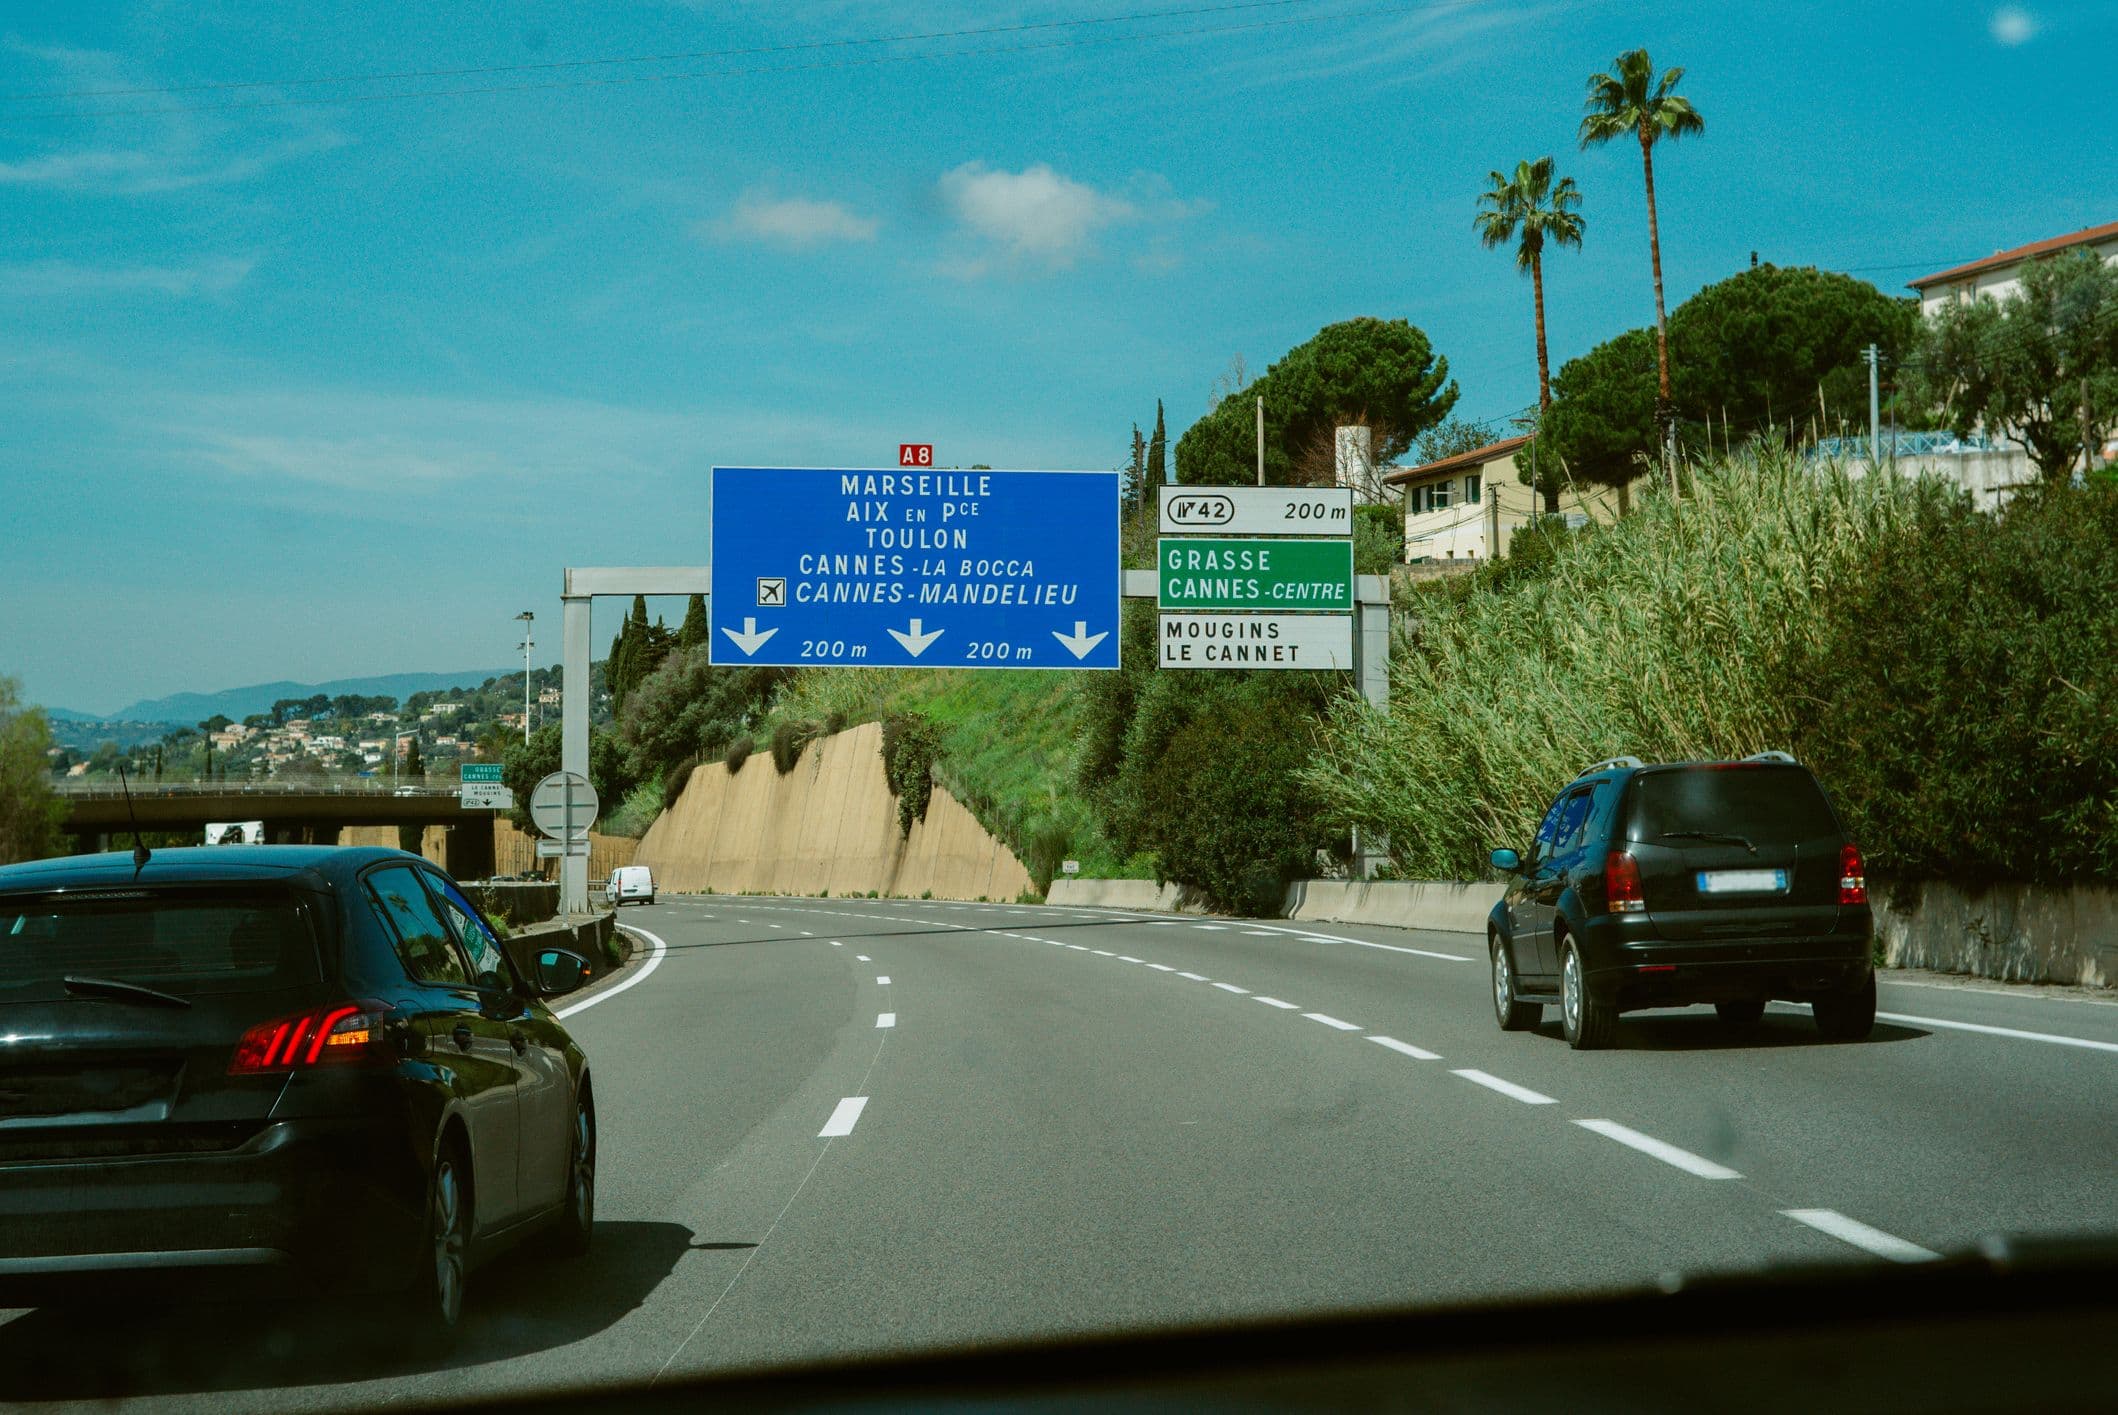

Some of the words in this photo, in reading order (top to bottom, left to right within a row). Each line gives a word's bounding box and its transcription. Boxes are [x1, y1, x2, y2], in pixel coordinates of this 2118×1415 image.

[903, 446, 930, 465] A8
[842, 475, 991, 496] MARSEILLE
[846, 502, 889, 522] AIX
[905, 509, 926, 522] EN
[1198, 502, 1226, 519] 42
[1284, 503, 1326, 520] 200
[1330, 507, 1346, 520] m
[866, 528, 967, 549] TOULON
[960, 560, 1034, 577] BOCCA
[1169, 549, 1270, 571] GRASSE
[1167, 622, 1279, 640] MOUGINS
[800, 640, 845, 658] 200
[850, 645, 867, 658] m
[966, 642, 1010, 660] 200
[1015, 647, 1033, 660] m
[1167, 644, 1192, 661] LE
[1206, 645, 1299, 662] CANNET
